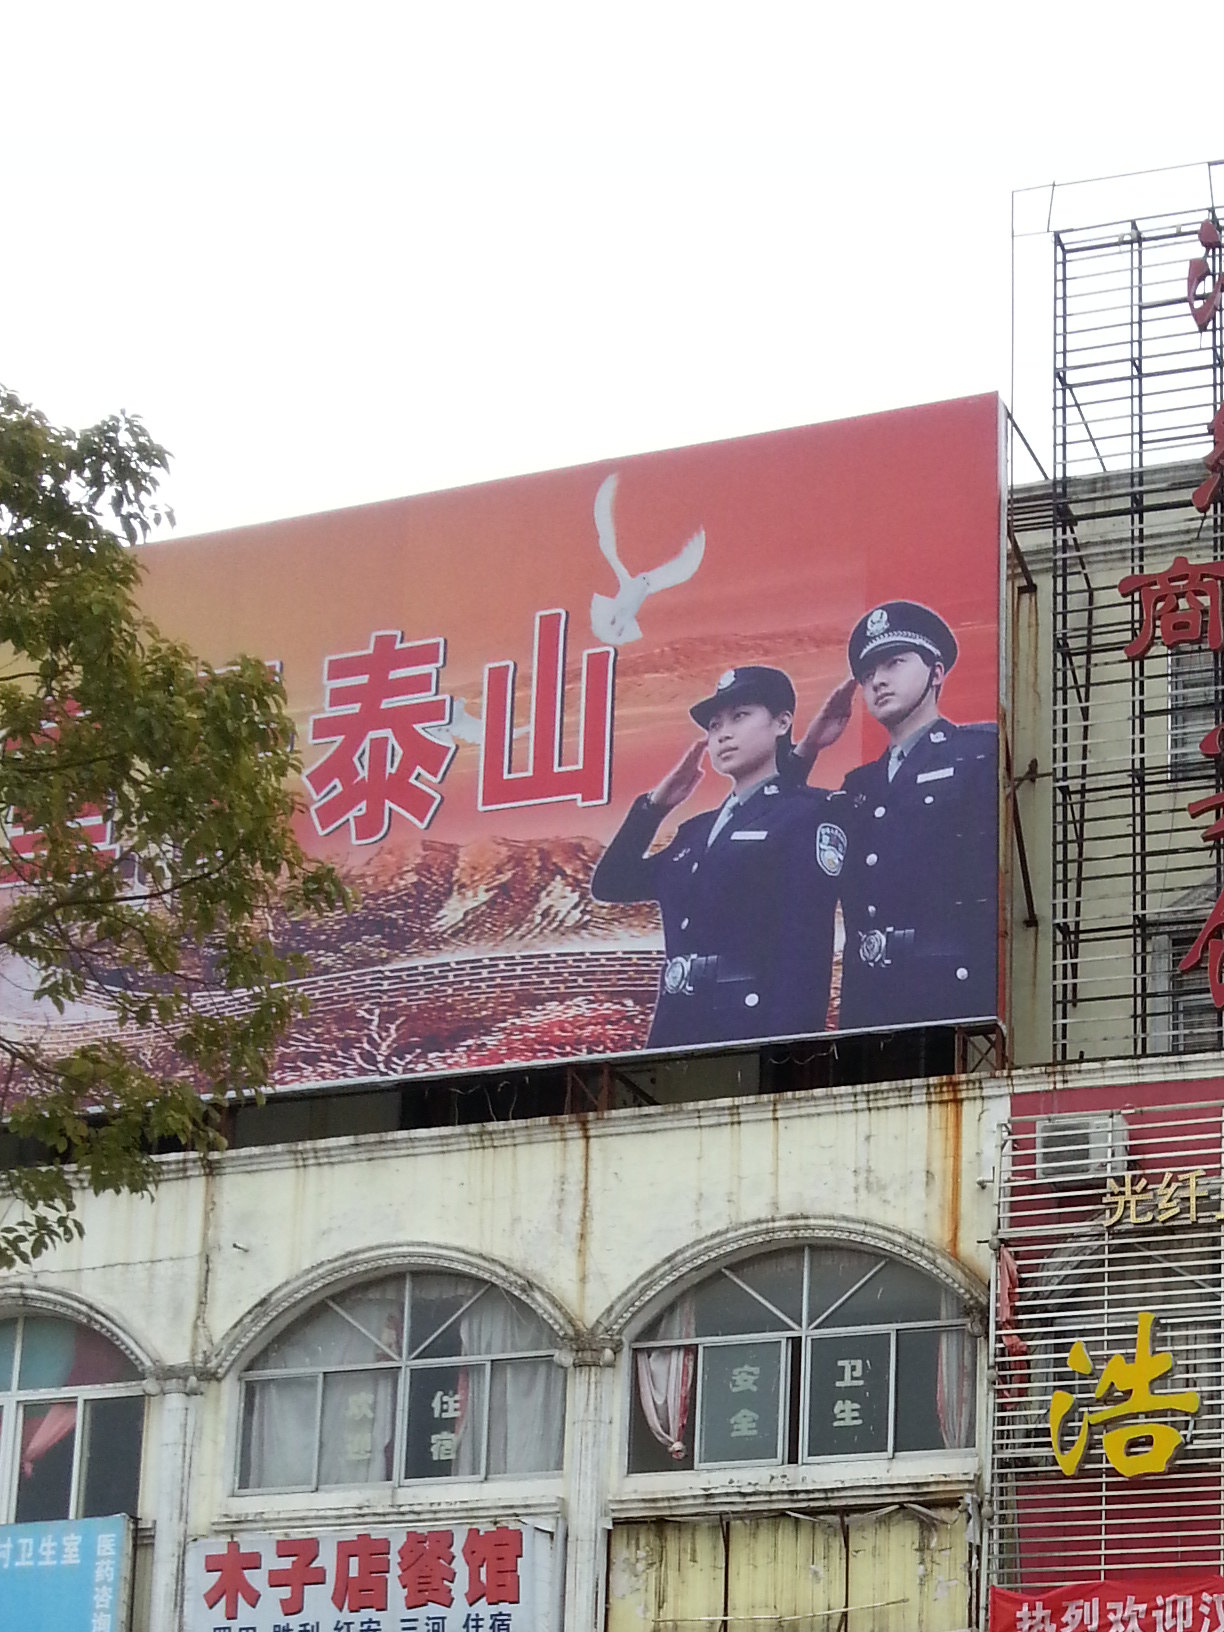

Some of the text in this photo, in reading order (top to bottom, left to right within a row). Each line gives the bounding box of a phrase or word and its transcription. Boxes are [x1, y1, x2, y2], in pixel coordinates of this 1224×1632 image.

[431, 1390, 461, 1460] 住宿
[729, 1363, 761, 1438] 安全
[832, 1359, 864, 1428] 卫生
[204, 1526, 523, 1621] 木子店餐馆
